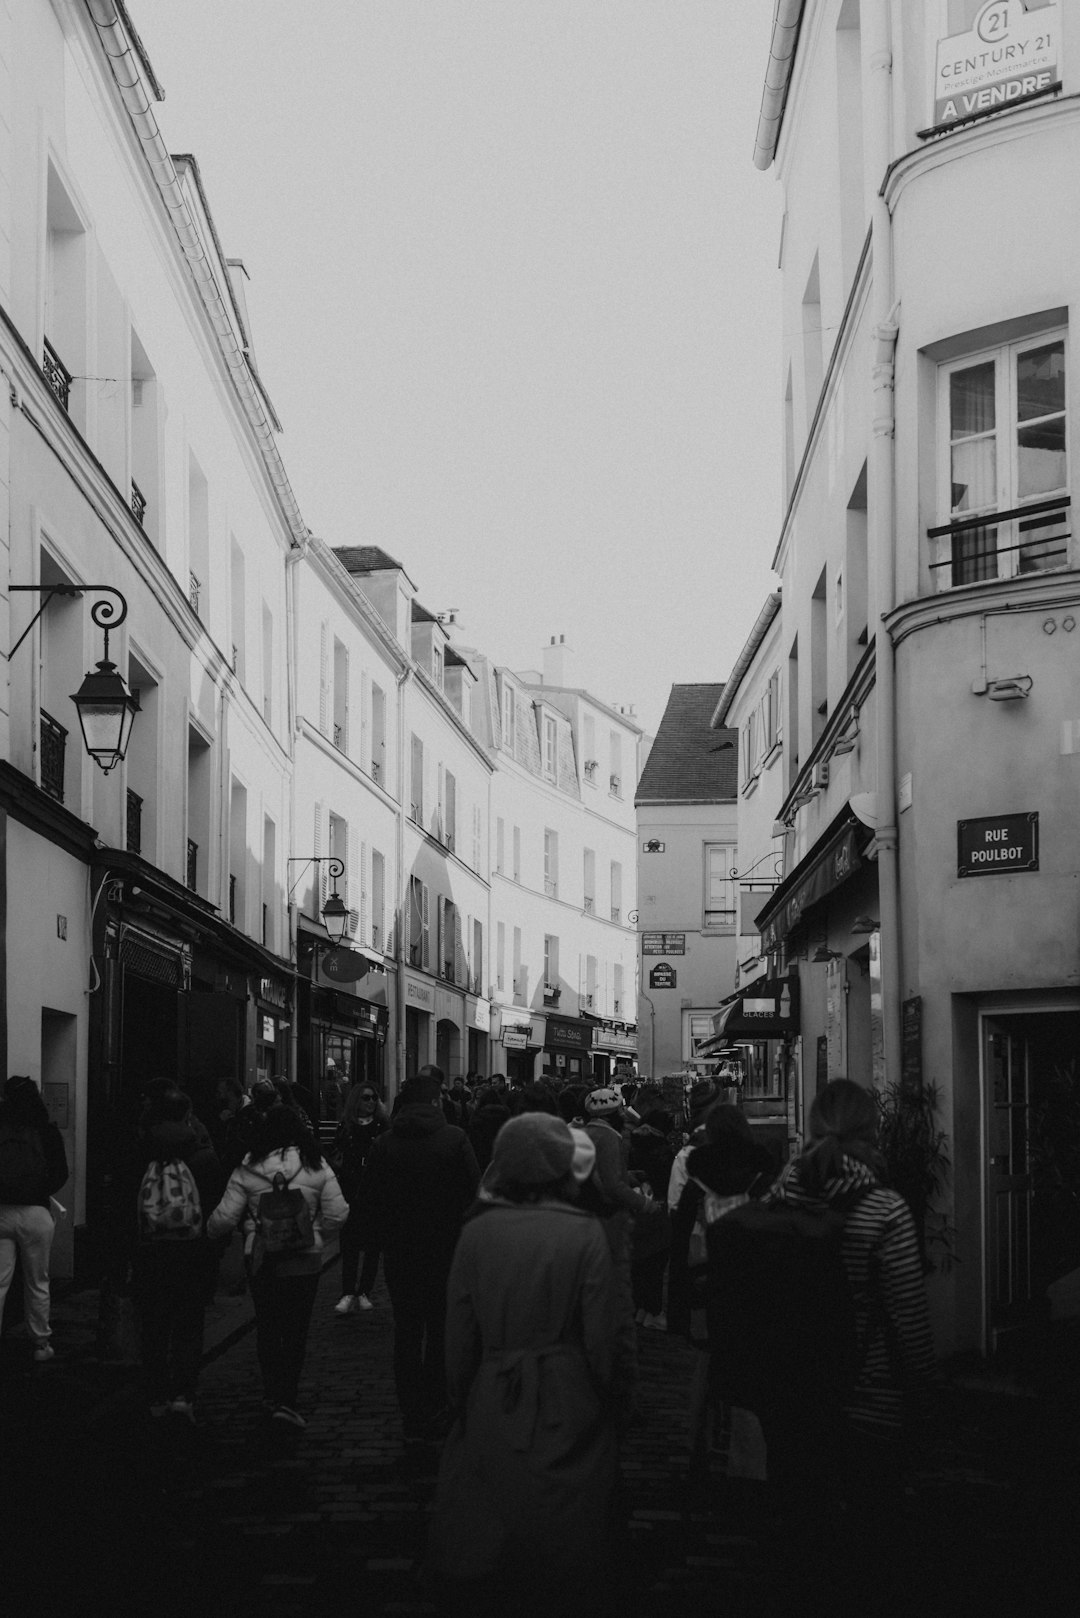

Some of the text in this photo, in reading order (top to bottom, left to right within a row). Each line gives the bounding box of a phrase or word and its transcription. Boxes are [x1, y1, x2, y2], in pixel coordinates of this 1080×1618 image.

[940, 34, 1051, 78] CENTURY 21
[941, 71, 1051, 120] A VENDRE
[985, 828, 1009, 842] RUE
[971, 846, 1024, 863] POULBOT
